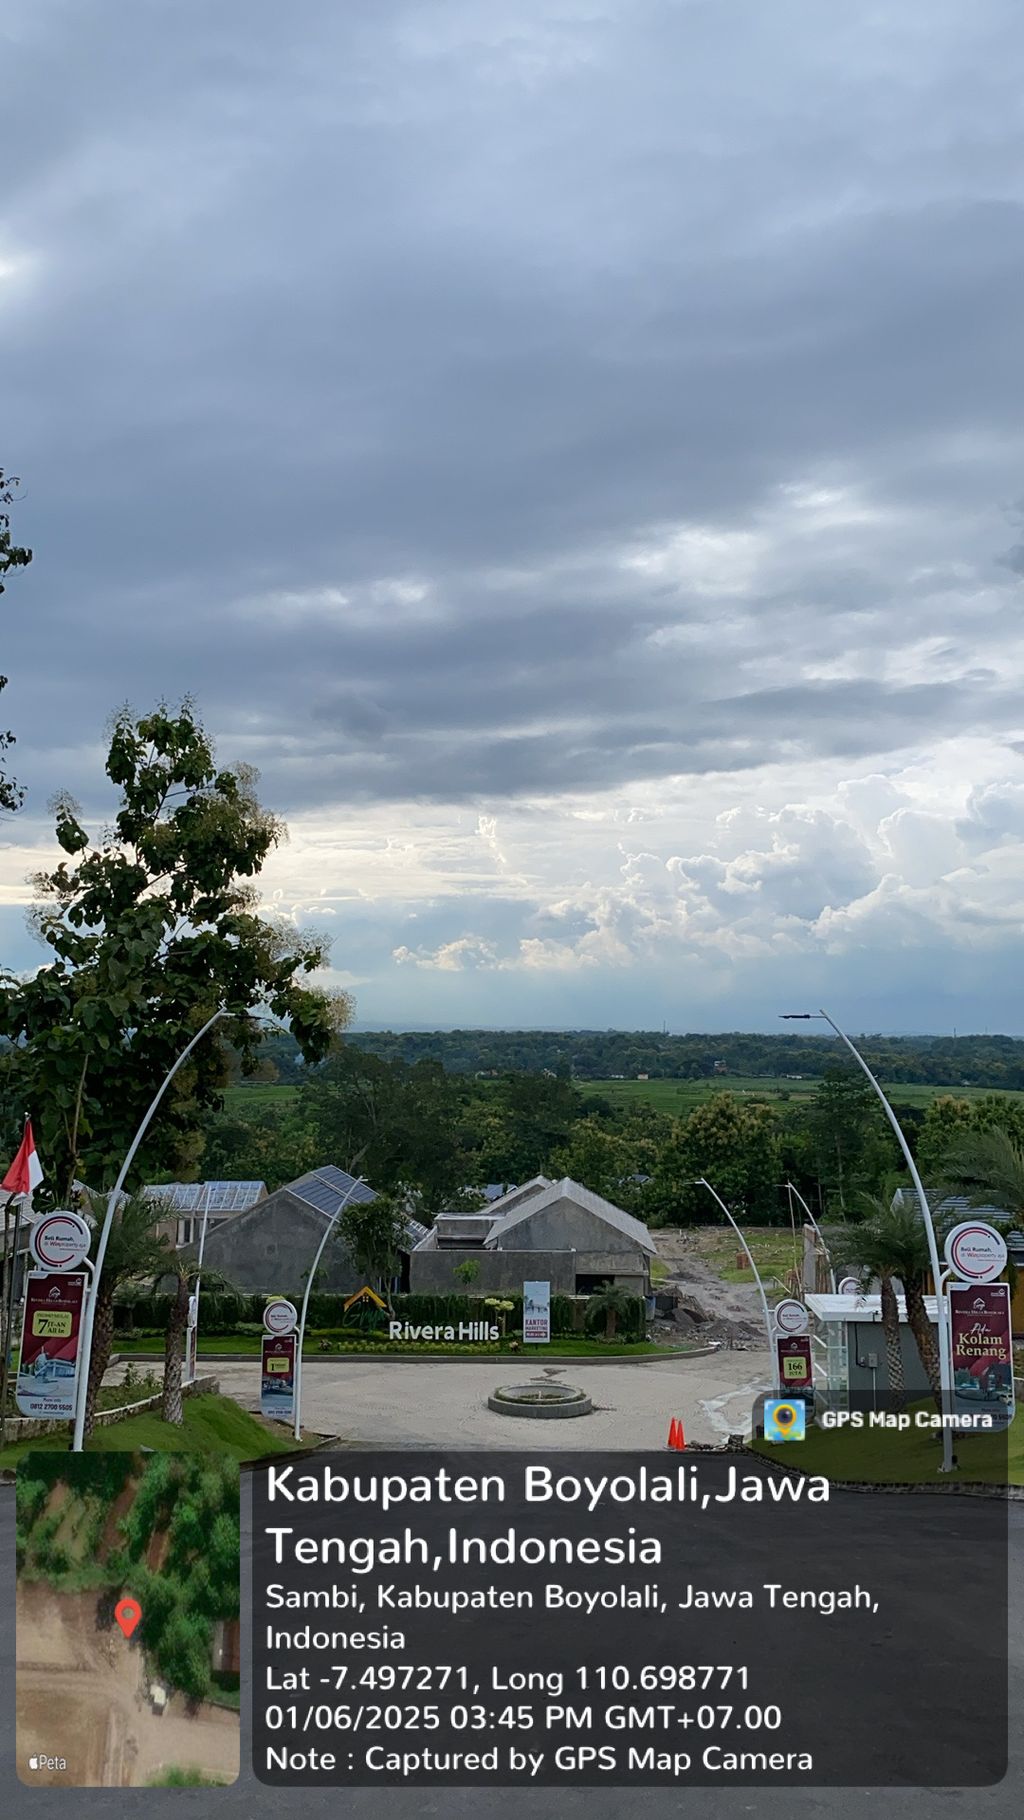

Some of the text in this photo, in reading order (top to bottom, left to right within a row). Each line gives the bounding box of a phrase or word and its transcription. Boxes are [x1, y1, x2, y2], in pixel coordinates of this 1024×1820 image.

[38, 1318, 49, 1334] 7
[389, 1321, 500, 1341] Rivera Hills
[959, 1332, 1003, 1345] Kolam
[956, 1344, 1007, 1360] Renang
[788, 1362, 803, 1371] 166
